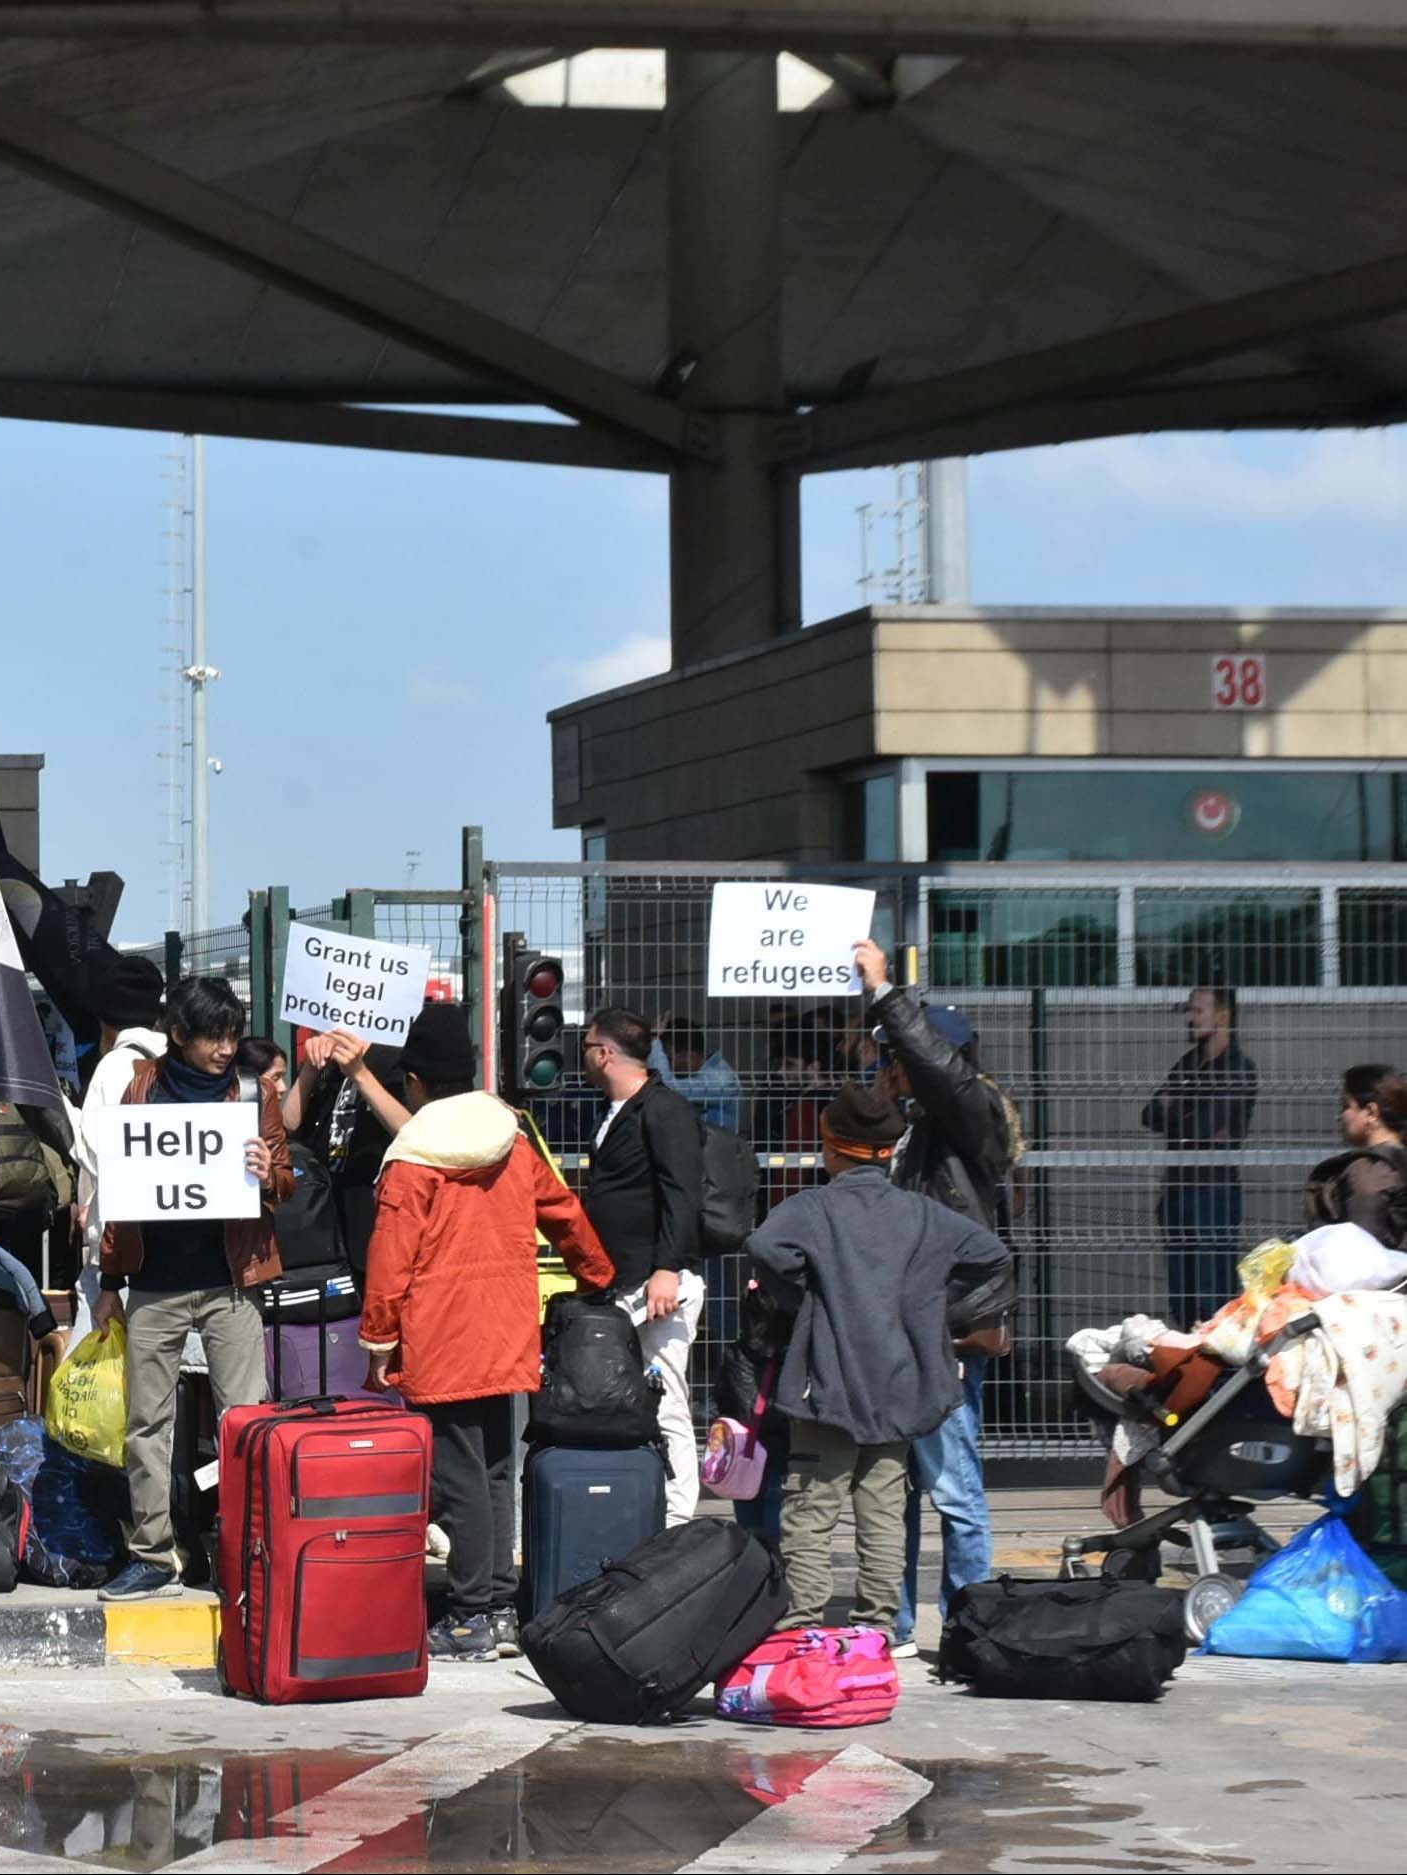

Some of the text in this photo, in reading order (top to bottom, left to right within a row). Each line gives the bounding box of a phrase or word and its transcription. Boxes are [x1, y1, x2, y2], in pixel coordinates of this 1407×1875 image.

[1215, 658, 1262, 704] 38
[765, 889, 809, 911] We
[760, 928, 805, 947] are
[304, 936, 410, 976] Grant us
[325, 971, 385, 1002] legal
[722, 959, 851, 990] refugees
[123, 1121, 224, 1165] Help
[156, 1183, 208, 1211] us
